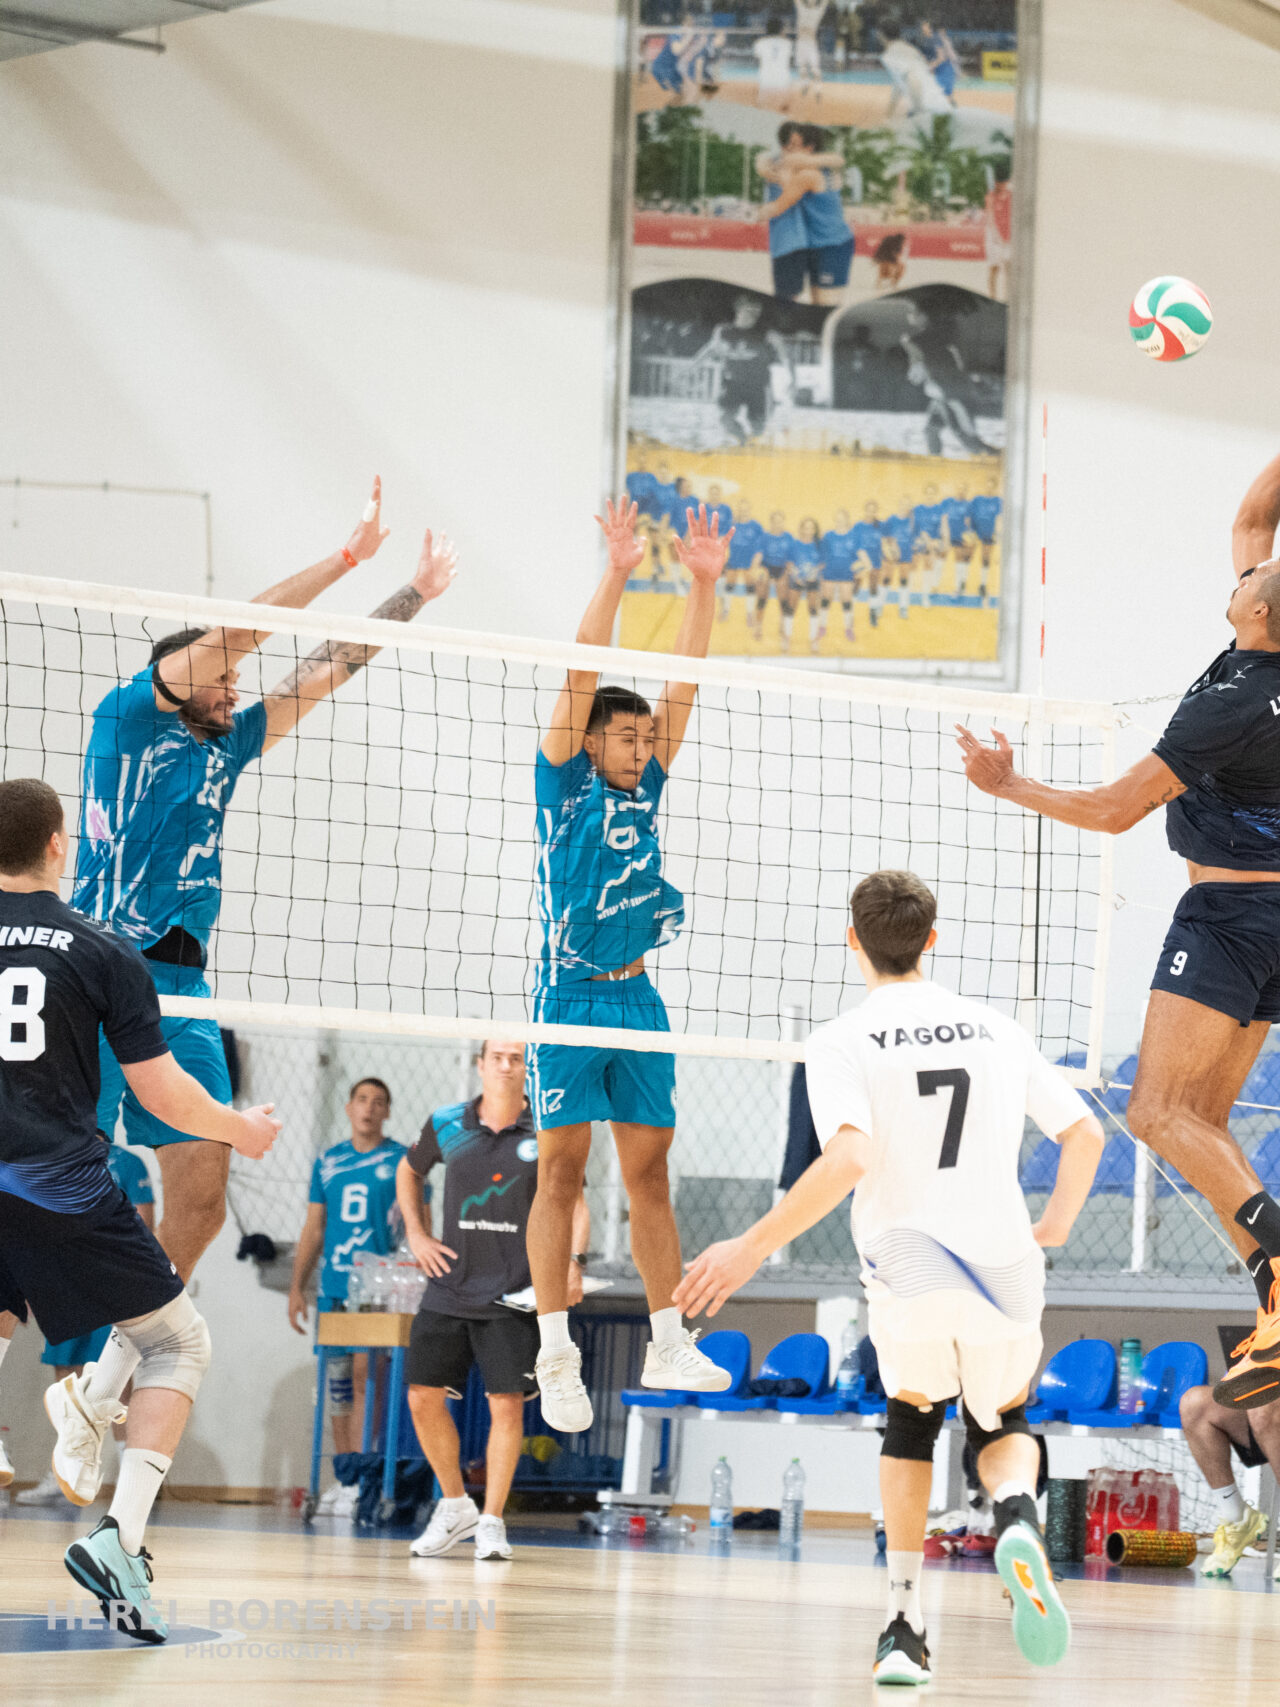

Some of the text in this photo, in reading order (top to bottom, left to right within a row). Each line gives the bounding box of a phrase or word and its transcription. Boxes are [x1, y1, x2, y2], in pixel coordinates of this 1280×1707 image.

[0, 926, 74, 951] INER
[1169, 950, 1189, 976] 9
[0, 967, 47, 1062] 8
[868, 1022, 995, 1050] YAGODA
[541, 1088, 566, 1115] 12
[916, 1068, 971, 1169] 7
[340, 1183, 369, 1223] 6
